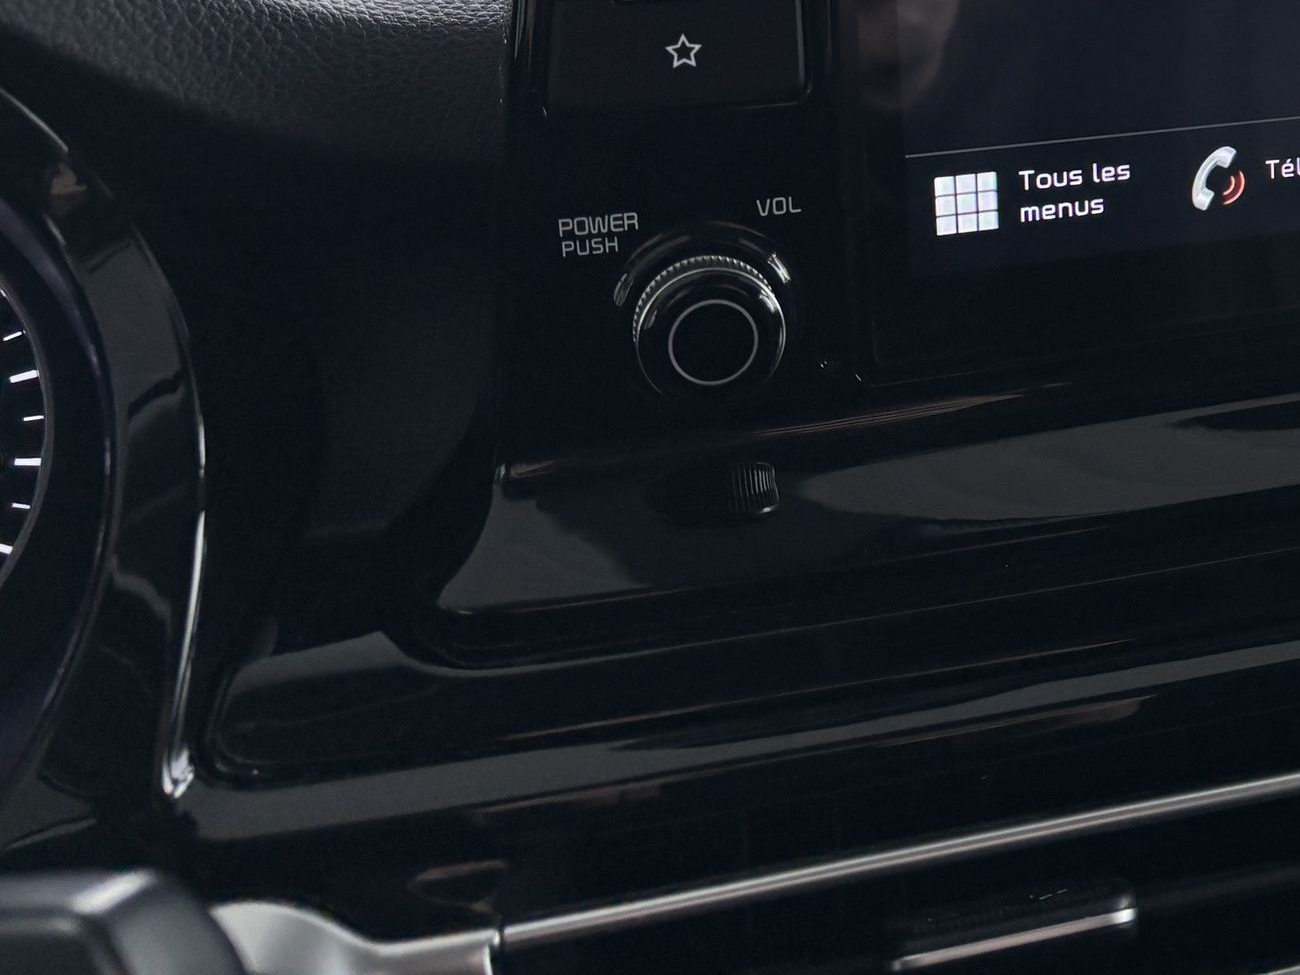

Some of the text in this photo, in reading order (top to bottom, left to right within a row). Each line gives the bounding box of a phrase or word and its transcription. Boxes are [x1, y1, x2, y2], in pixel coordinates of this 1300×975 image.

[1018, 162, 1131, 191] Tous les
[756, 196, 802, 217] VOL
[1020, 198, 1105, 223] menus
[558, 211, 639, 238] POWER
[560, 236, 620, 258] PUSH
